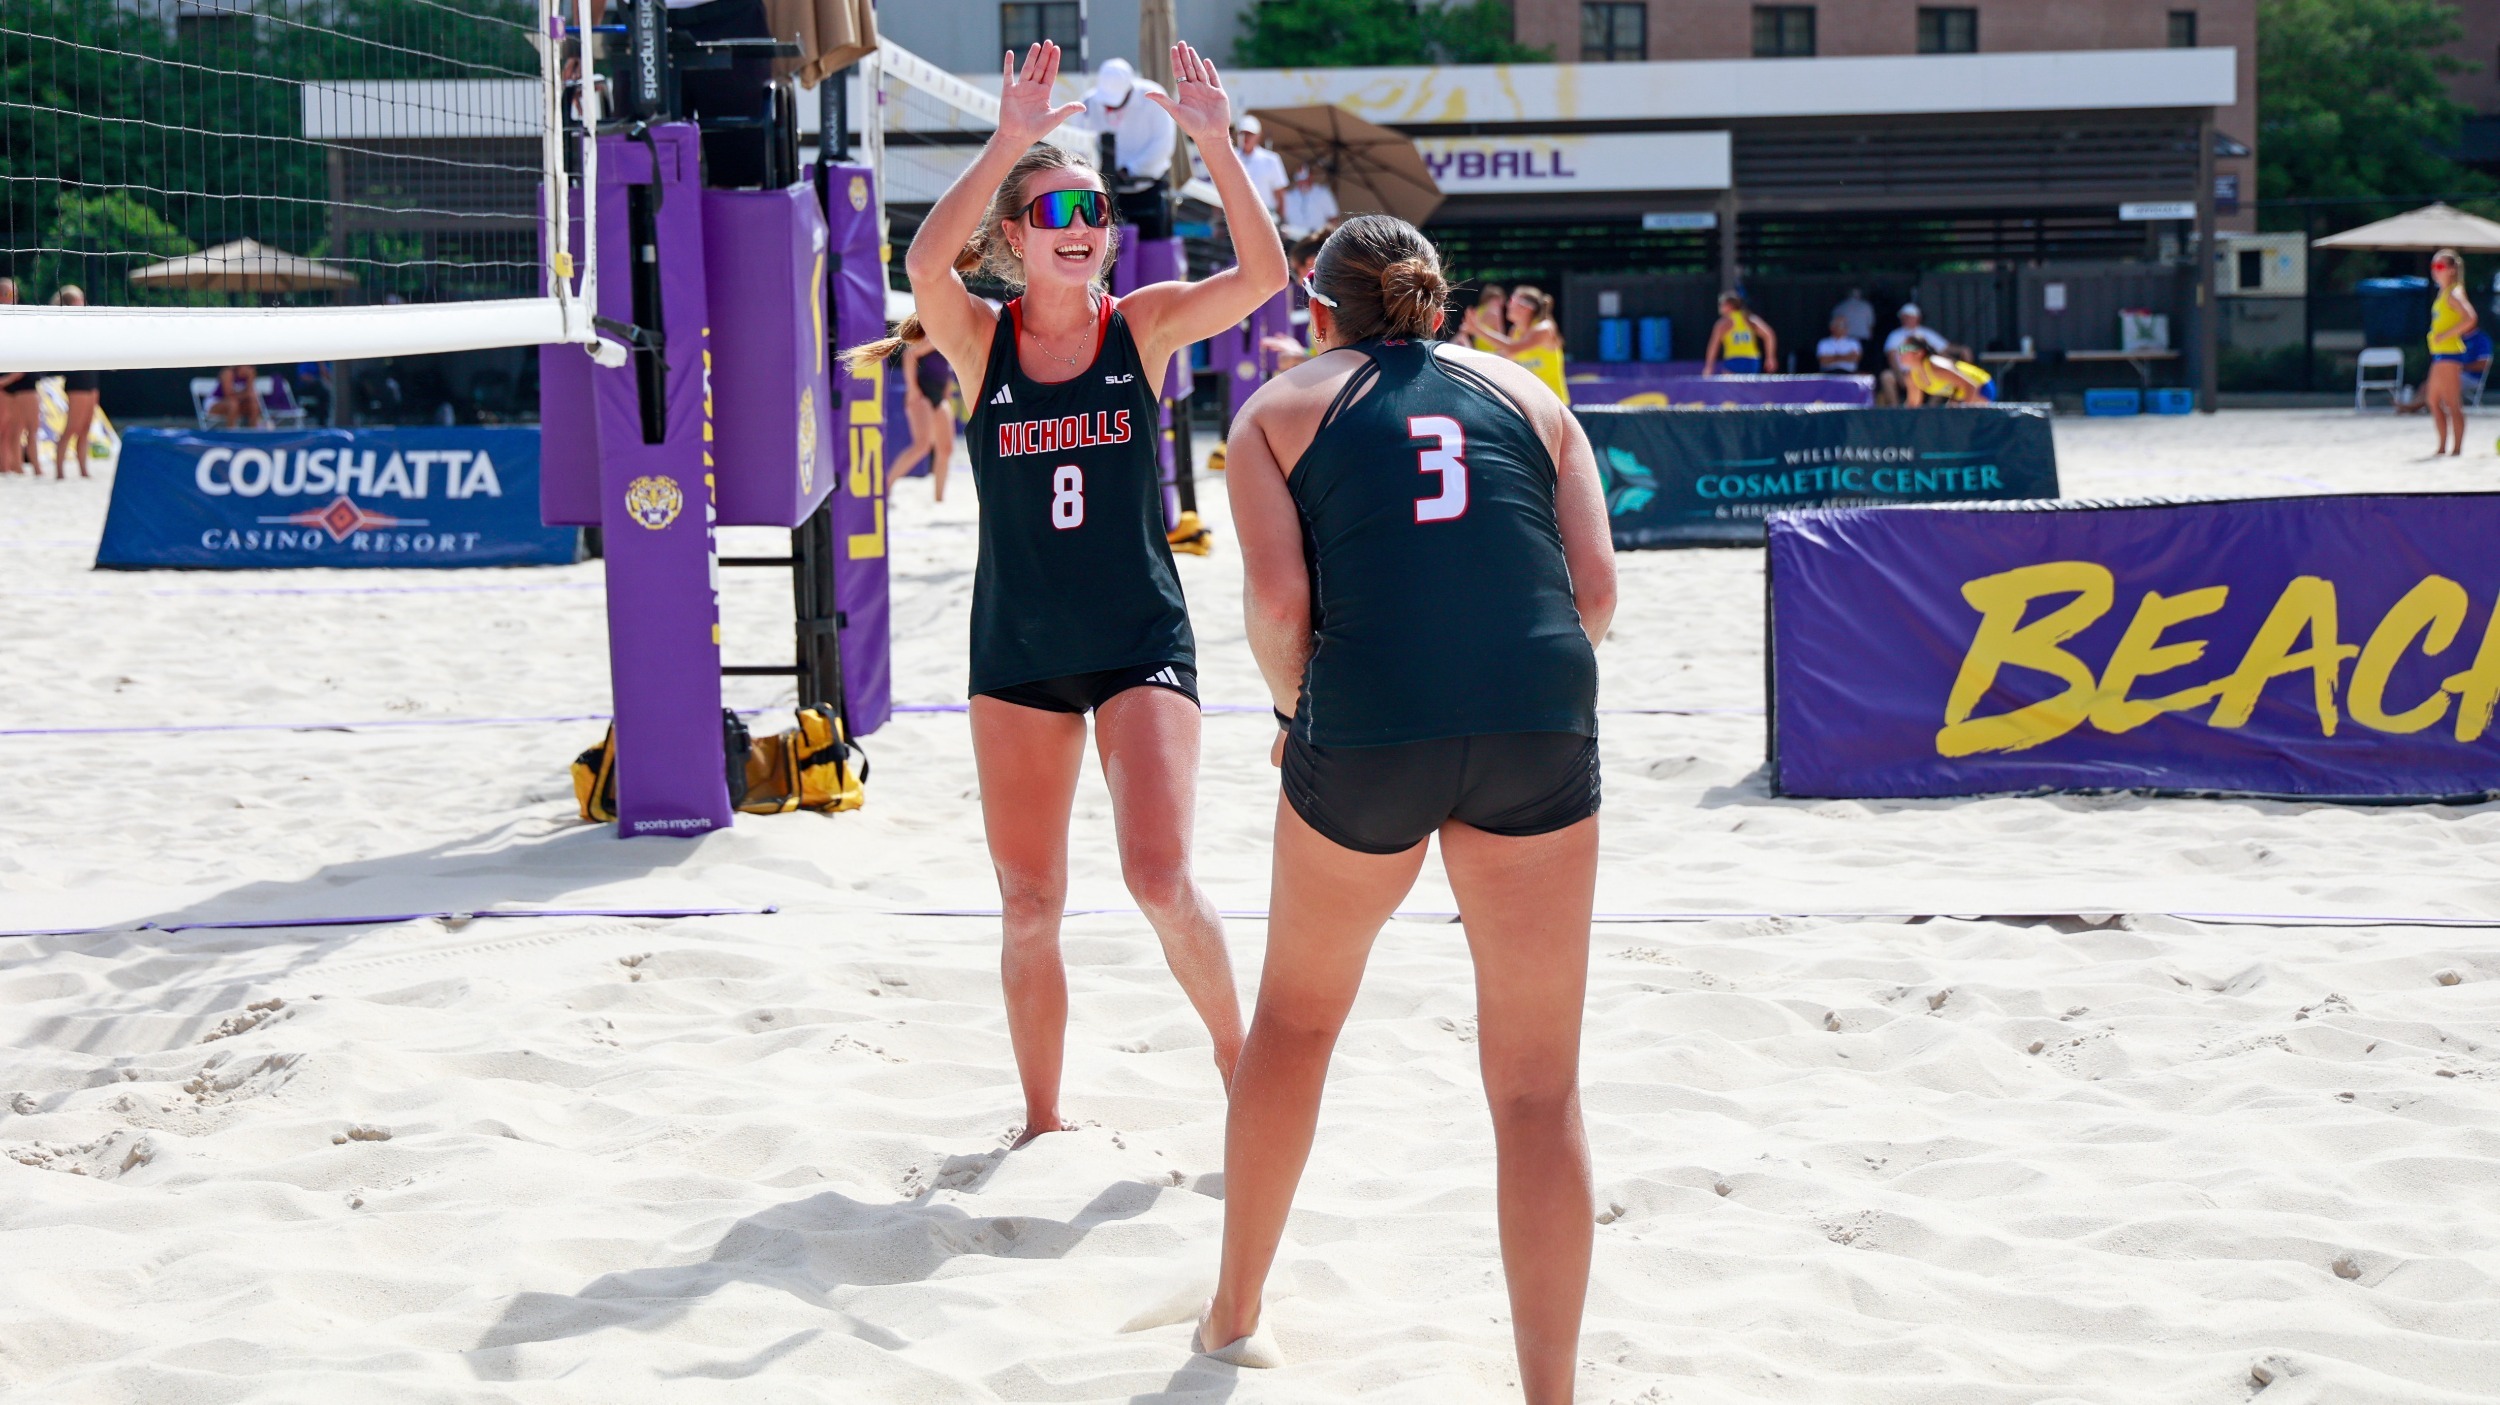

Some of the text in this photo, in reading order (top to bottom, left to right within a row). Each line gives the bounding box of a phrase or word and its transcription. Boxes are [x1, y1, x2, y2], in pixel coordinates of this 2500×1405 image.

[640, 30, 658, 99] imports
[999, 409, 1132, 457] NICHOLLS
[1784, 447, 1914, 465] WILLIAMSON
[195, 447, 502, 499] COUSHATTA
[1407, 414, 1470, 524] 3
[1696, 464, 2005, 499] COSMETIC CENTER
[1052, 465, 1084, 529] 8
[201, 529, 481, 552] CASINO RESORT
[634, 817, 712, 831] sports imports
